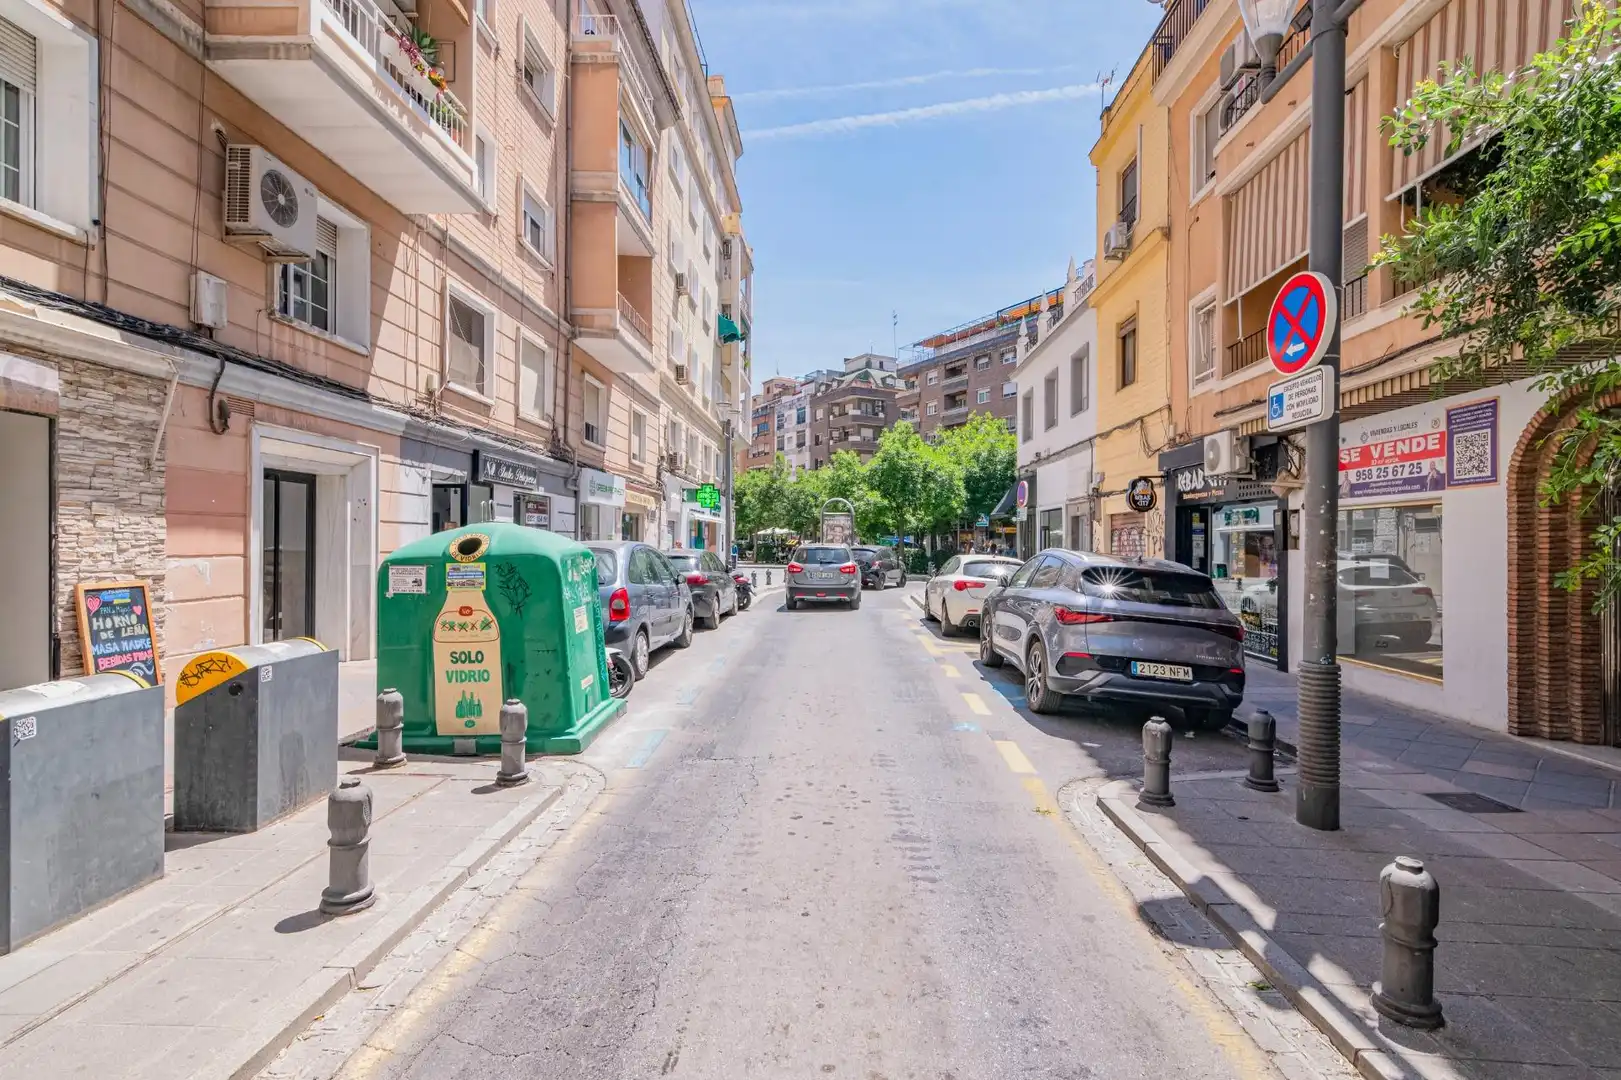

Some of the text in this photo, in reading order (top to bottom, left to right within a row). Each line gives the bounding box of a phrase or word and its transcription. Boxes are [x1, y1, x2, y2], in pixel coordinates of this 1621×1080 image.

[1288, 386, 1317, 401] DE PERSONAS
[1296, 395, 1319, 409] MOVILIDAD
[1292, 408, 1312, 419] REDUCIDA
[1369, 426, 1393, 437] VIVIENDAS
[1398, 421, 1418, 432] LOCALES
[1339, 447, 1361, 464] SE
[1370, 433, 1440, 459] VENDE
[1177, 468, 1205, 492] KEBAB
[1355, 462, 1423, 482] 958 25 67 25
[92, 613, 138, 631] HORNO
[100, 623, 149, 640] DE LEÑA
[92, 637, 152, 656] MASA MADRE
[449, 650, 485, 665] SOLO
[445, 669, 491, 684] VIDRIO
[1139, 663, 1190, 678] 2123 NFM
